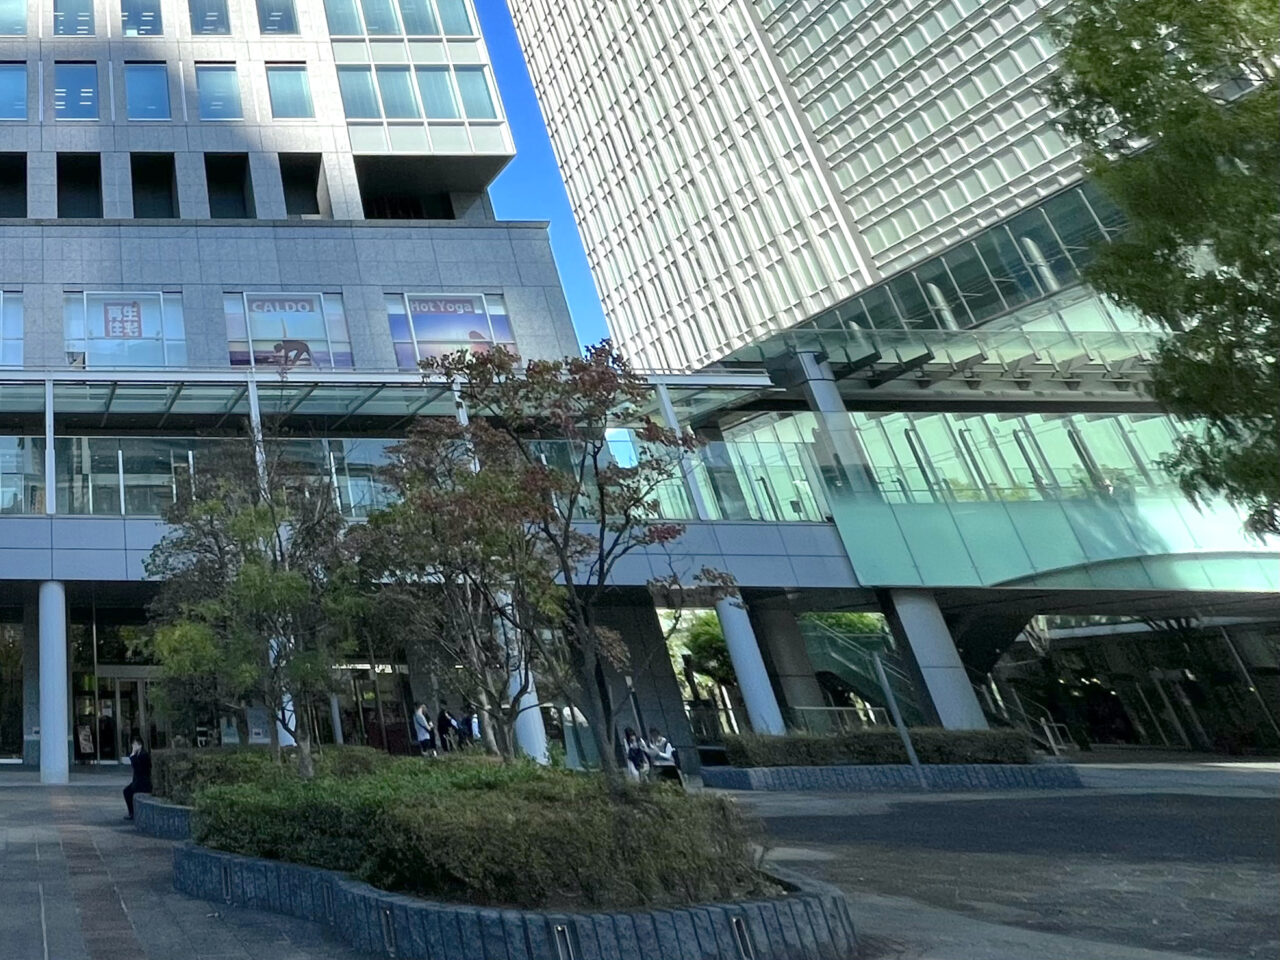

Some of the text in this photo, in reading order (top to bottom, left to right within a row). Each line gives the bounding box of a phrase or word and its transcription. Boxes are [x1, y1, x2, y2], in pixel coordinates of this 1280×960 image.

[252, 301, 310, 313] CALDO
[410, 301, 473, 314] Hot Yoga
